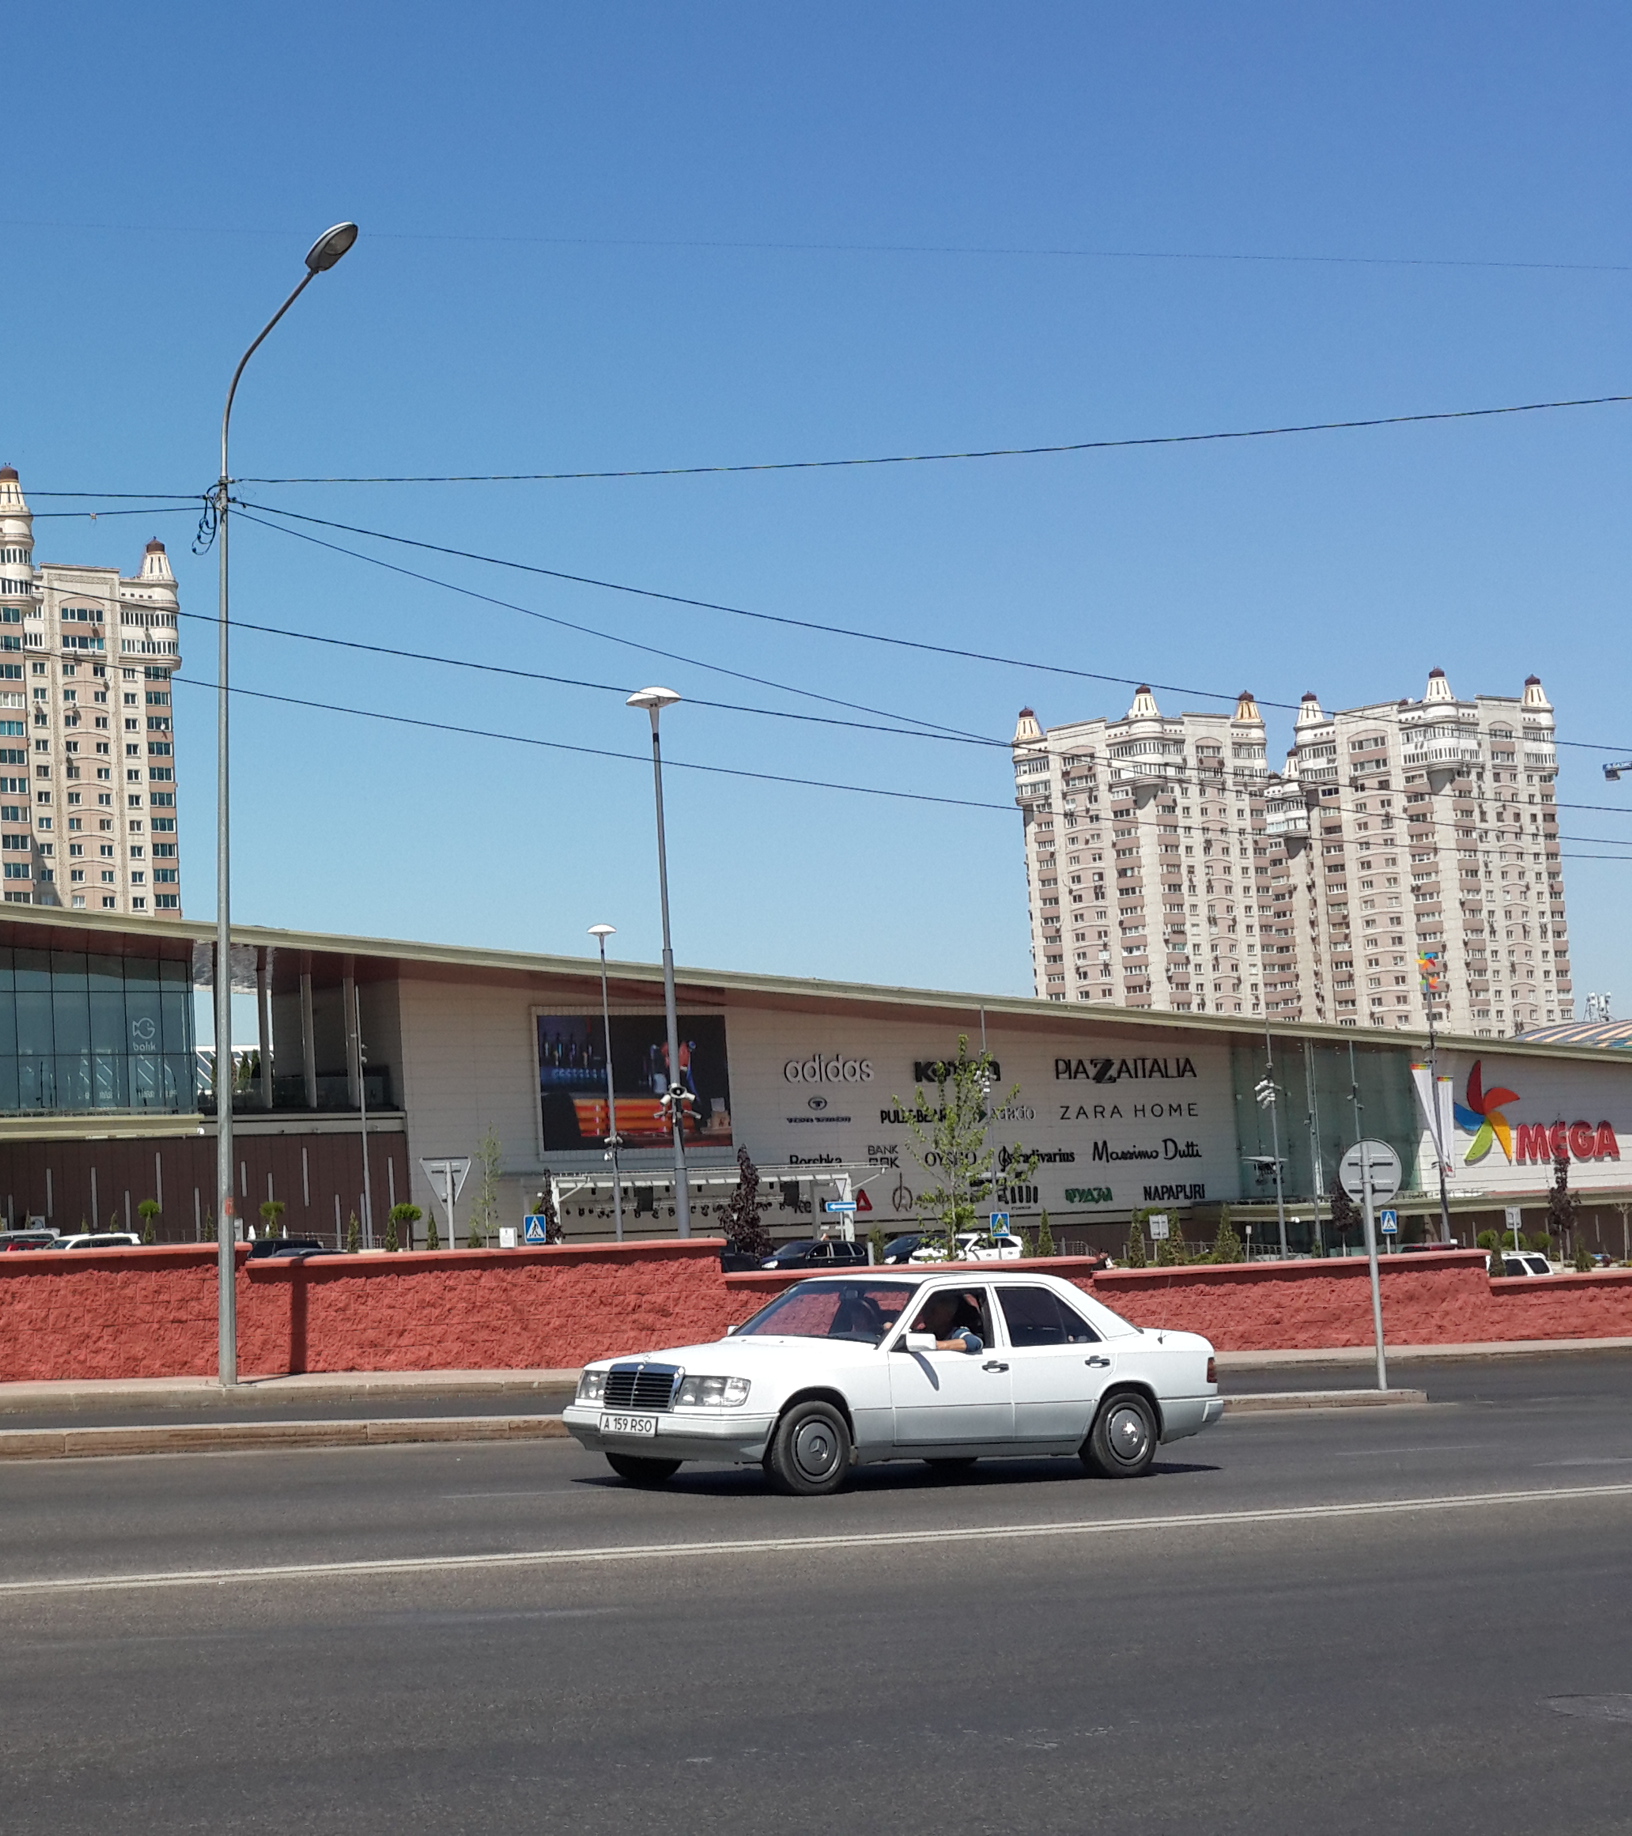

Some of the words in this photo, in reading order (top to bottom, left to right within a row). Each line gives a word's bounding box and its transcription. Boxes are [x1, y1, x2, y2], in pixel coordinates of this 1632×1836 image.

[783, 1053, 875, 1083] adidas
[1059, 1104, 1123, 1120] ZARA
[1134, 1102, 1199, 1118] HOME
[867, 1144, 899, 1155] BANK
[1092, 1139, 1159, 1163] Massimo
[1161, 1137, 1202, 1160] Dutti
[1516, 1120, 1620, 1161] MEGA
[1001, 1147, 1075, 1167] Sradivarius
[603, 1417, 610, 1429] A
[613, 1417, 628, 1431] 159
[630, 1418, 652, 1433] RSO
